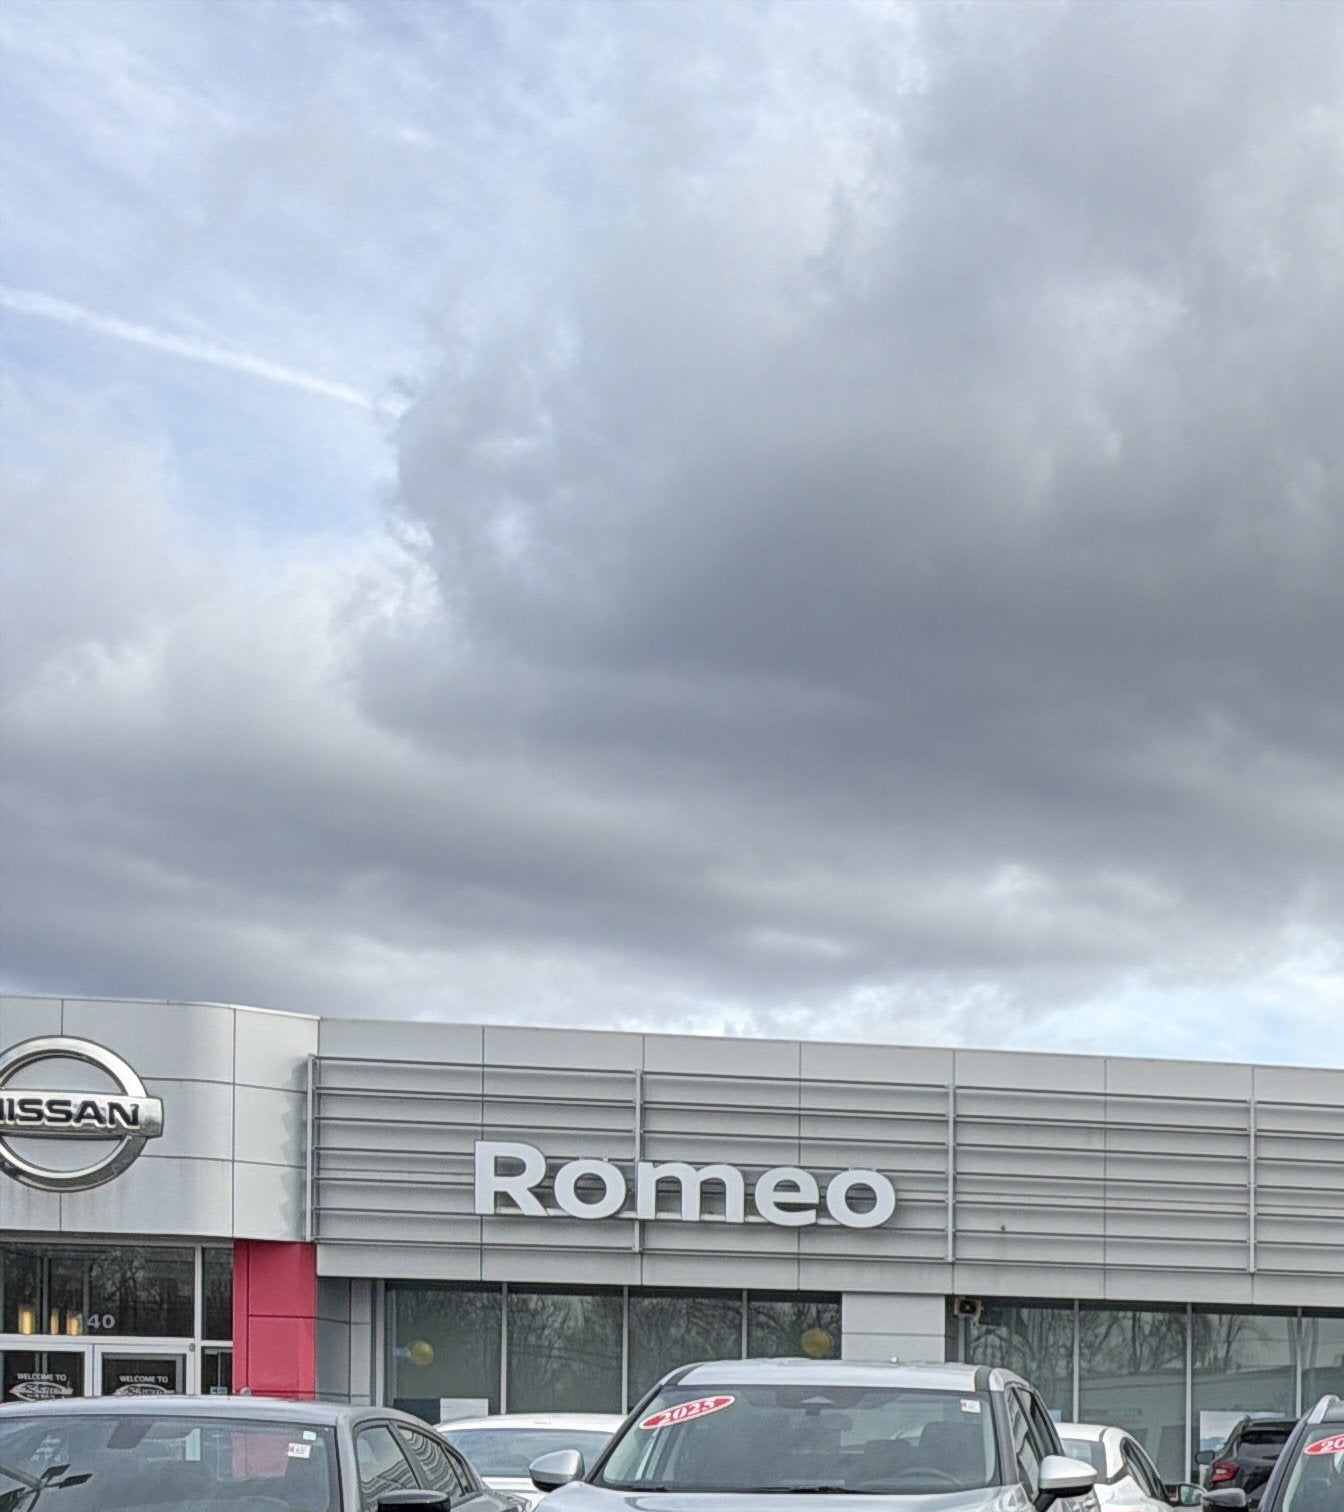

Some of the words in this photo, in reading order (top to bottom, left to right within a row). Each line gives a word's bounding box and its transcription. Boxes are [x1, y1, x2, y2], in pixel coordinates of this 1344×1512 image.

[0, 1097, 140, 1127] ISSAN
[474, 1140, 896, 1228] Romeo
[55, 1374, 67, 1382] TO
[157, 1375, 169, 1383] TO
[659, 1400, 715, 1425] 2025
